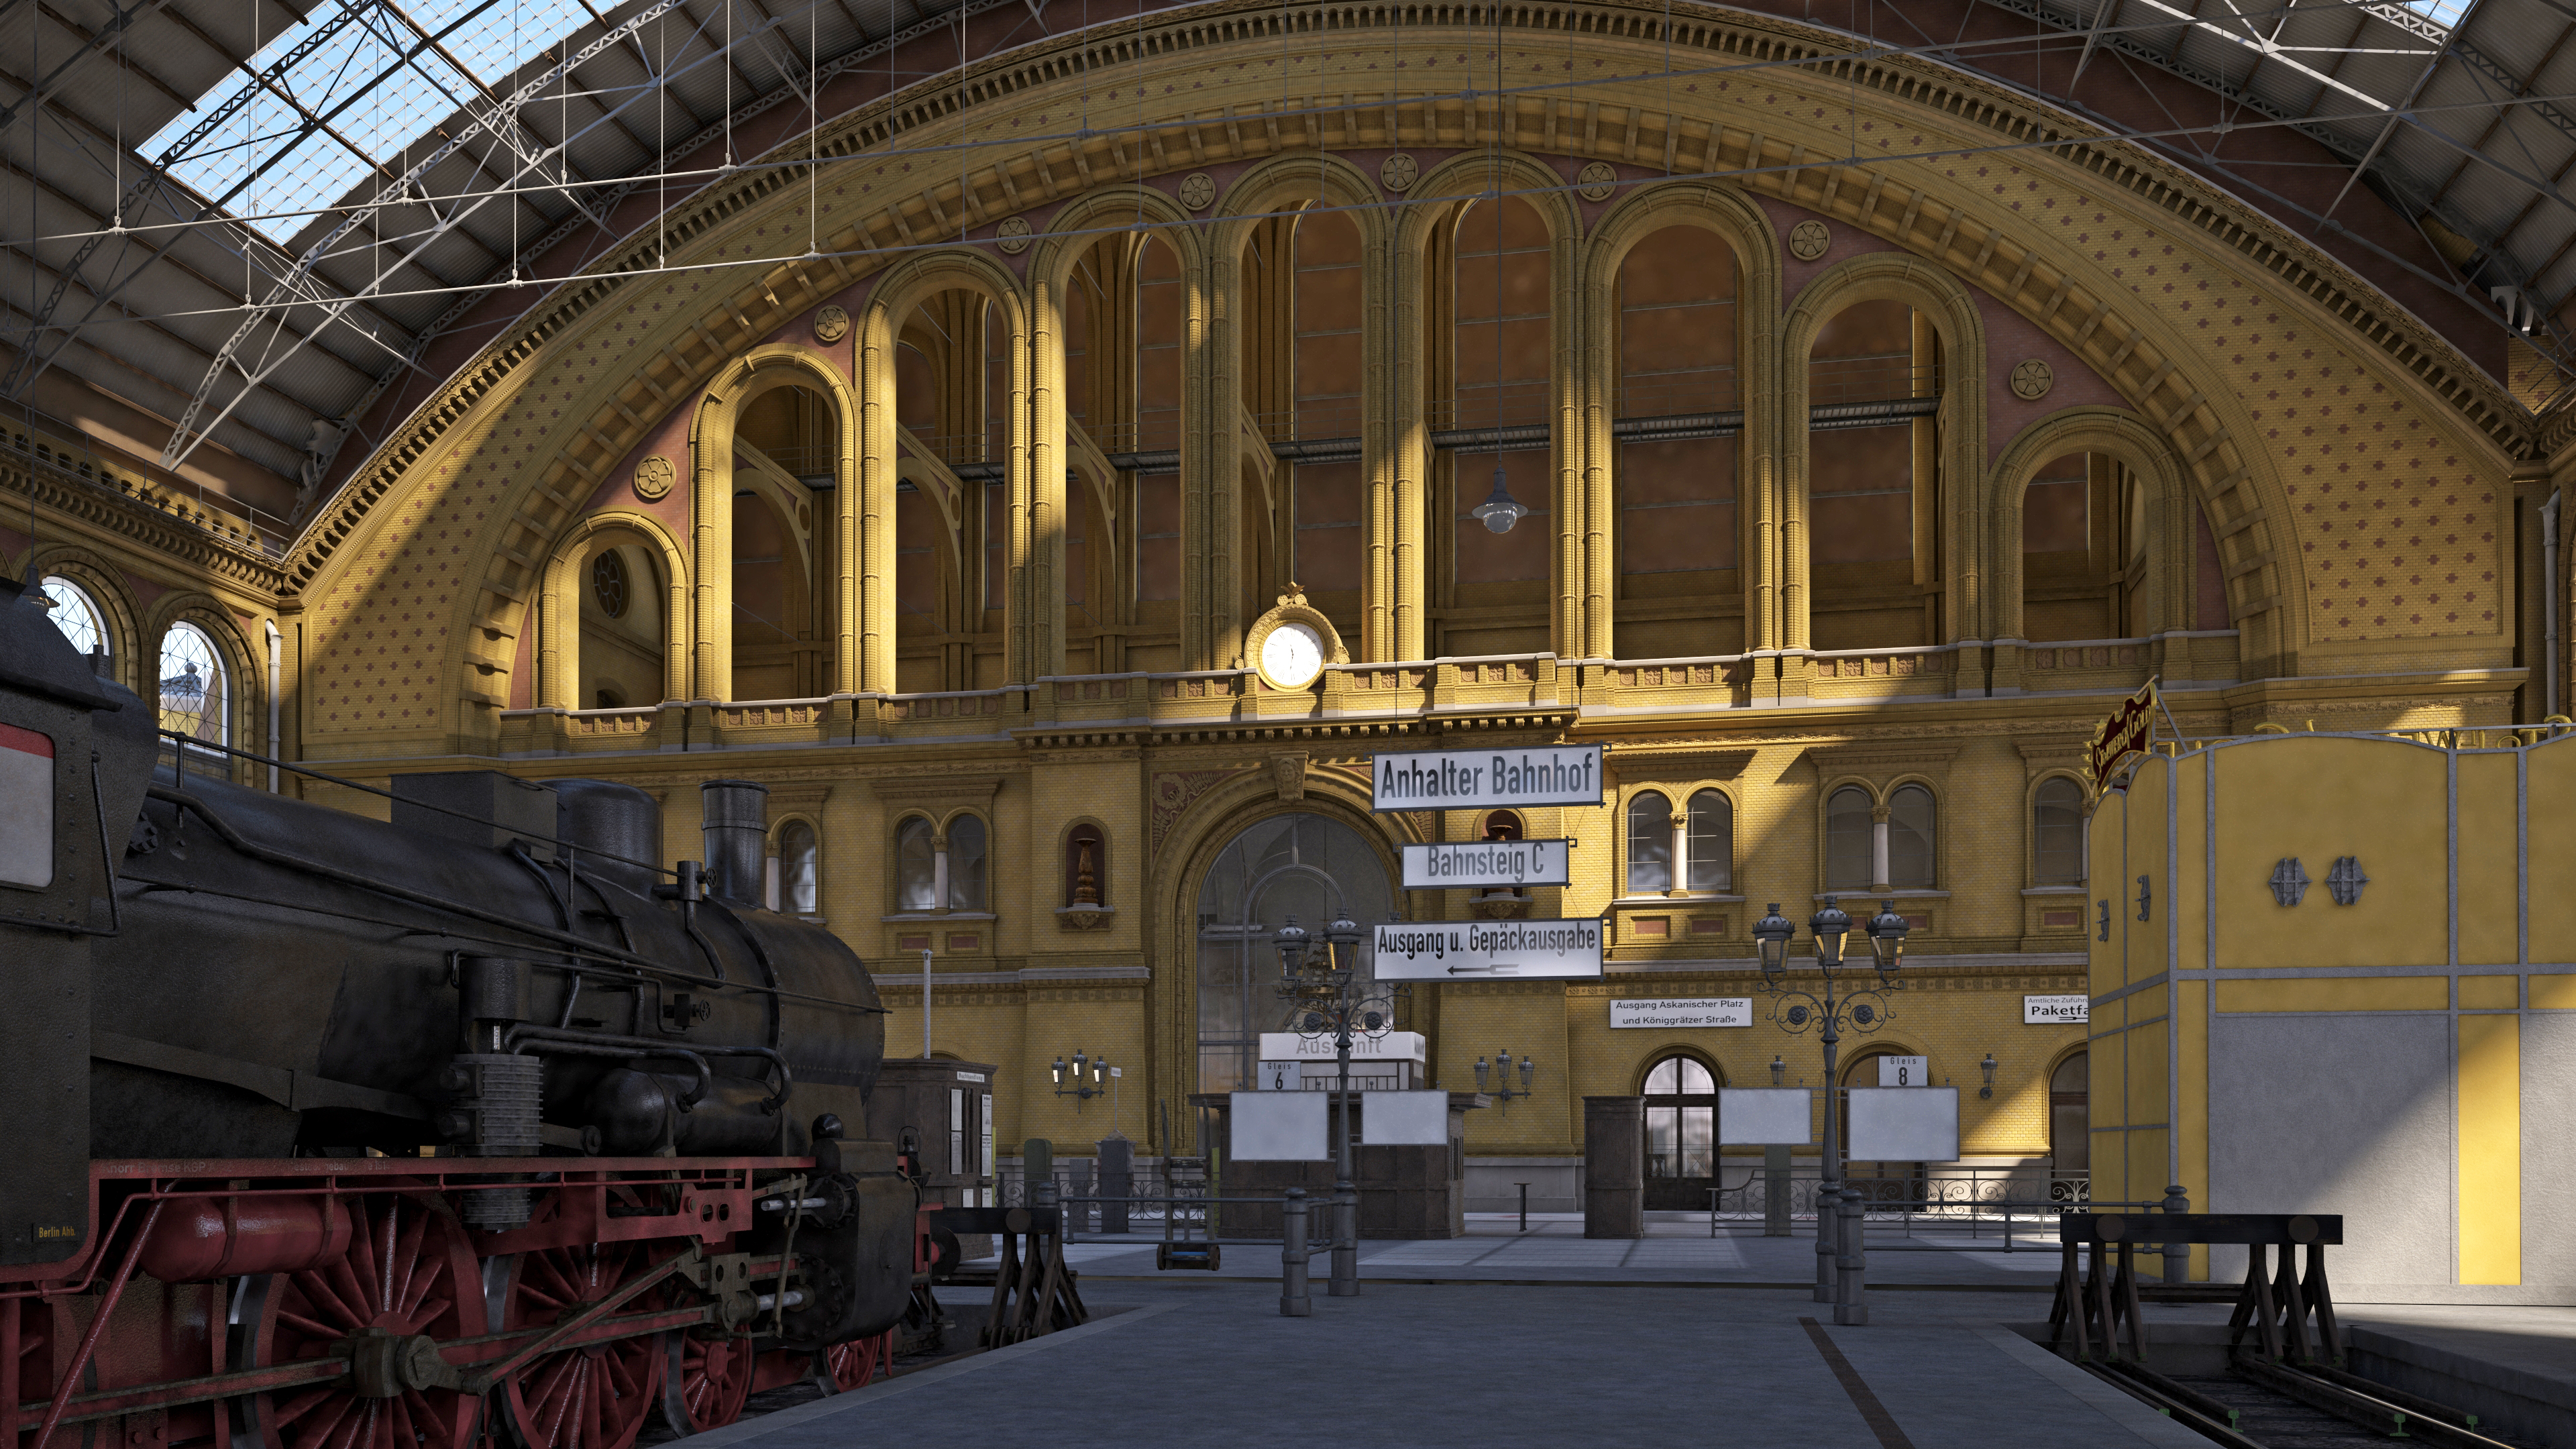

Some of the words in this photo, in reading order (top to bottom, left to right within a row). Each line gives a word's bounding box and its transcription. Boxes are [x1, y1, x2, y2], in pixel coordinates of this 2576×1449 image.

[1381, 758, 1483, 798] Anhalter
[1493, 753, 1592, 795] Bahnhof
[1428, 843, 1525, 883] Bahnsteig
[1532, 843, 1544, 874] C
[1378, 926, 1444, 961] Ausgang
[1450, 934, 1464, 953] u.
[1469, 922, 1595, 958] Gepäckausgabe
[1616, 1001, 1657, 1011] Ausgang
[1660, 1000, 1718, 1008] Askanischer
[1721, 1000, 1743, 1008] Platz
[1623, 1016, 1640, 1024] und
[1643, 1015, 1703, 1026] Königgrätzer
[1705, 1015, 1737, 1024] Straße
[1296, 1037, 1381, 1054] Ausnft
[1268, 1062, 1292, 1070] Gleis
[1890, 1057, 1917, 1065] Gleis
[959, 1072, 983, 1081] Buchhandlung
[1275, 1071, 1283, 1090] 6
[1898, 1067, 1908, 1086] 8
[39, 1226, 60, 1238] Berlin
[62, 1226, 76, 1237] Ahb.
